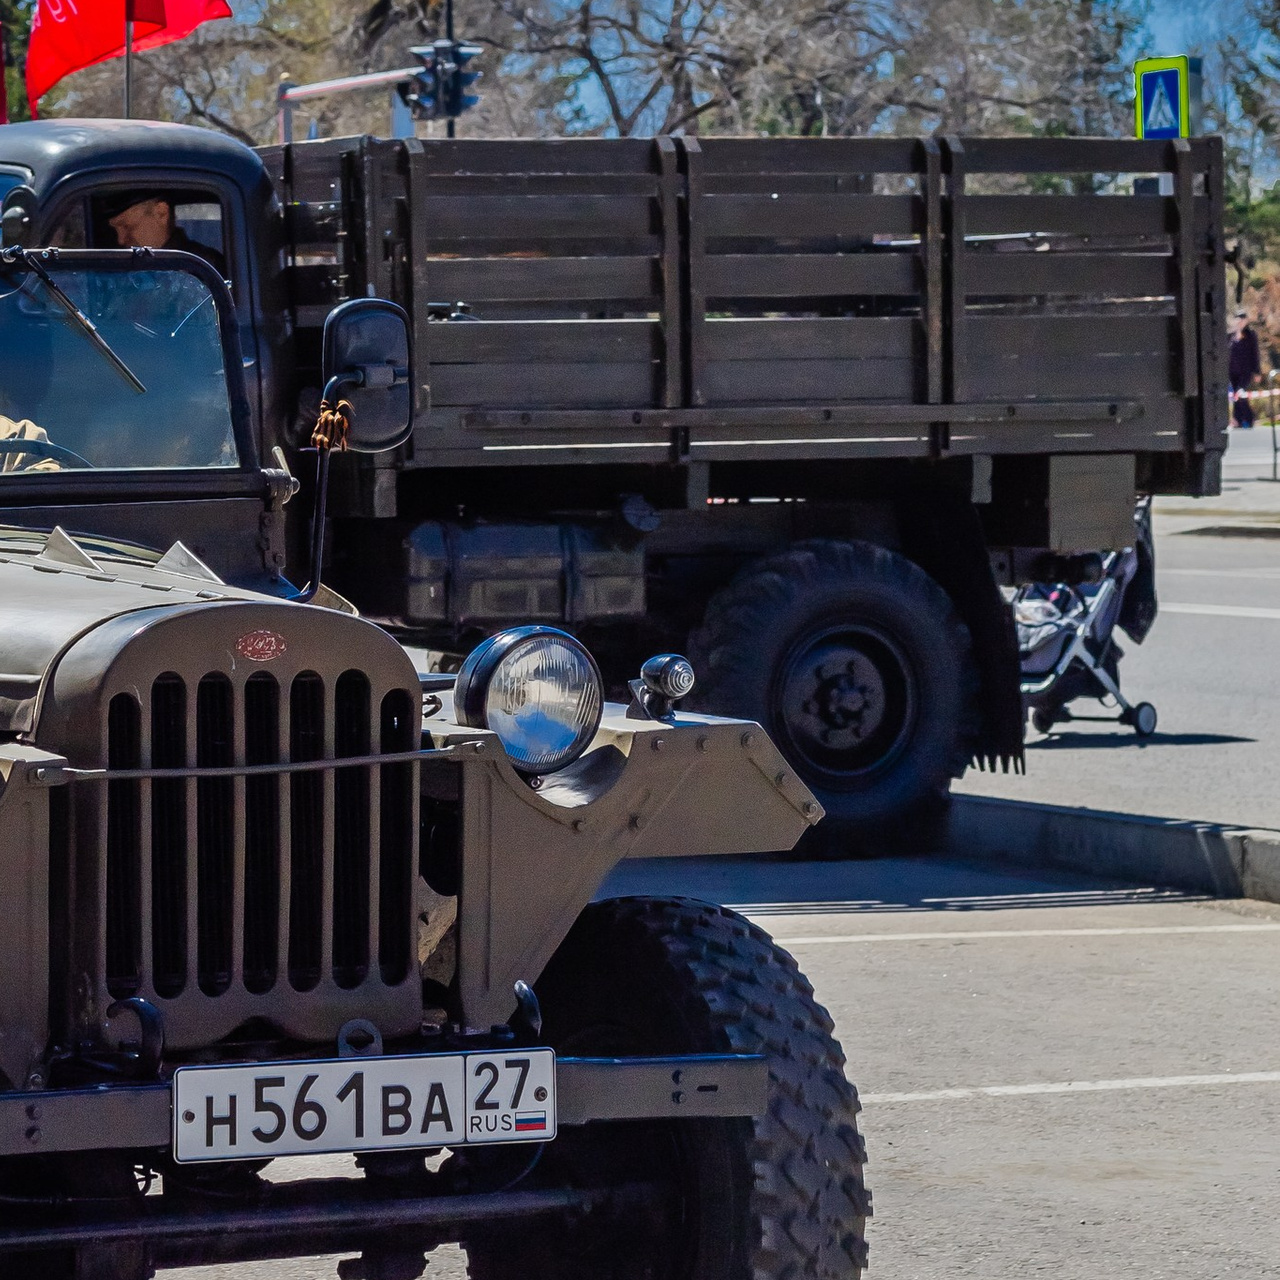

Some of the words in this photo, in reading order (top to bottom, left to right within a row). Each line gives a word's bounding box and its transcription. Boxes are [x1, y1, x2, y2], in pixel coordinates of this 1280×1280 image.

[205, 1071, 454, 1148] Н561ВА
[474, 1058, 531, 1111] 27
[470, 1113, 513, 1134] RUS
